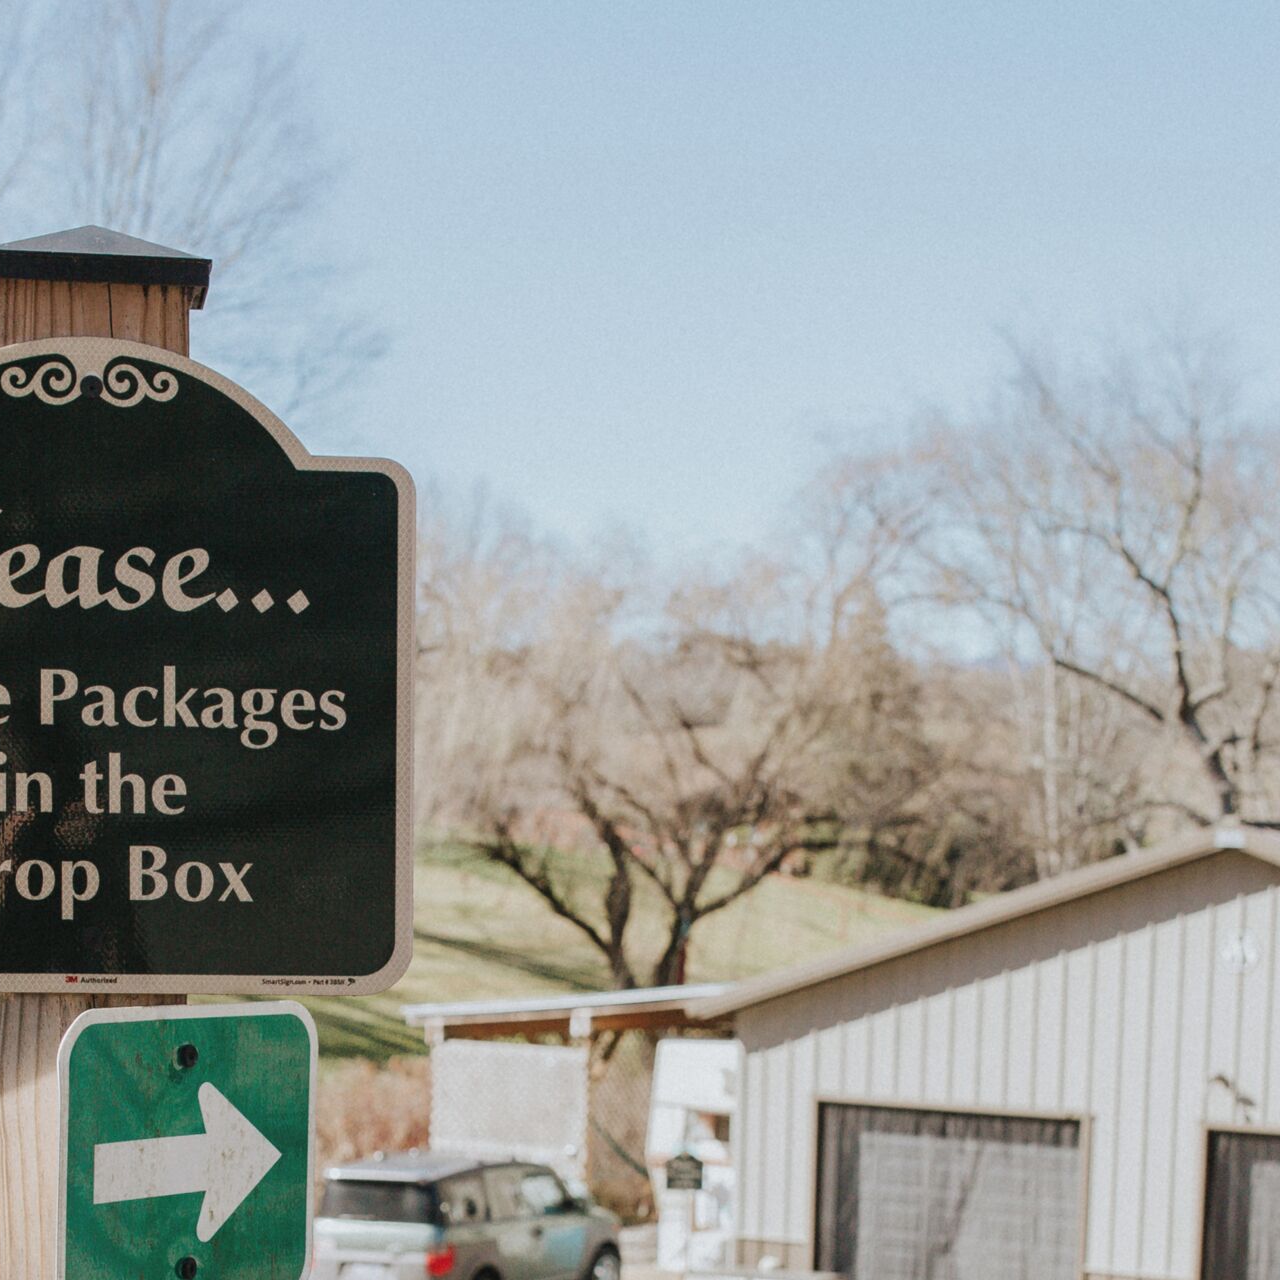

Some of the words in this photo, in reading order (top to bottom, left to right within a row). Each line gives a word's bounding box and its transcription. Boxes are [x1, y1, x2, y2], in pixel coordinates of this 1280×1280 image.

[41, 666, 347, 750] Packages
[80, 753, 187, 815] the
[130, 846, 254, 903] Box
